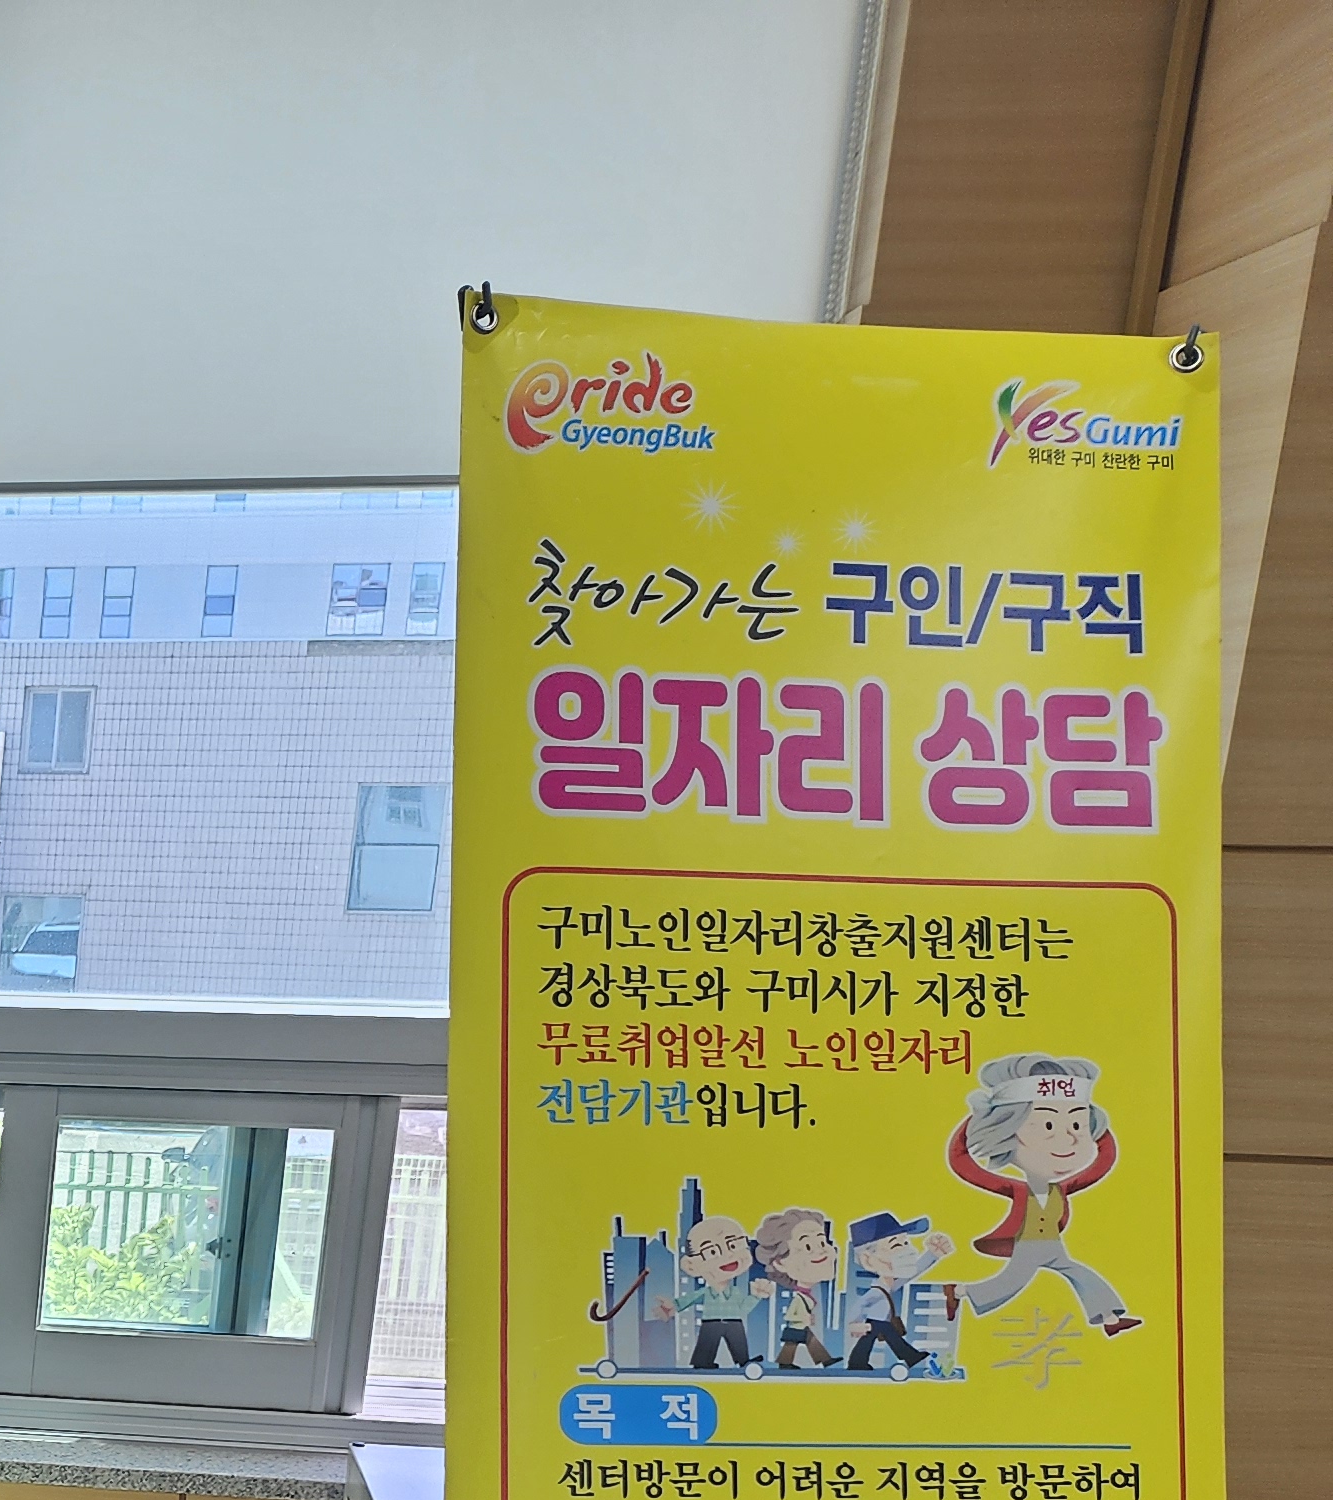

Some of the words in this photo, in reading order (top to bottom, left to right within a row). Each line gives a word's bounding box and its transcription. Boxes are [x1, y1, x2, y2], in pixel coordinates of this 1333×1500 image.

[560, 418, 716, 453] GyeongBuk
[1028, 447, 1066, 466] 위대한
[1071, 451, 1096, 468] 구미
[1102, 452, 1141, 470] 찬란한
[1147, 454, 1174, 470] 구미
[528, 538, 800, 647] 찾아가는
[825, 560, 1143, 655] 구인/구직
[534, 668, 887, 823] 일자리
[919, 684, 1165, 828] 상담
[537, 904, 1074, 964] 구미노인일자리창출지원센터는
[539, 966, 730, 1011] 경상북도와
[748, 968, 898, 1016] 구미시가
[914, 973, 1029, 1019] 지정한
[537, 1023, 765, 1069] 무료취업알선
[786, 1027, 971, 1074] 노인일자리
[537, 1080, 818, 1131] 전담기관입니다.
[1036, 1078, 1076, 1097] 취업
[558, 1460, 740, 1500] 센터방문이
